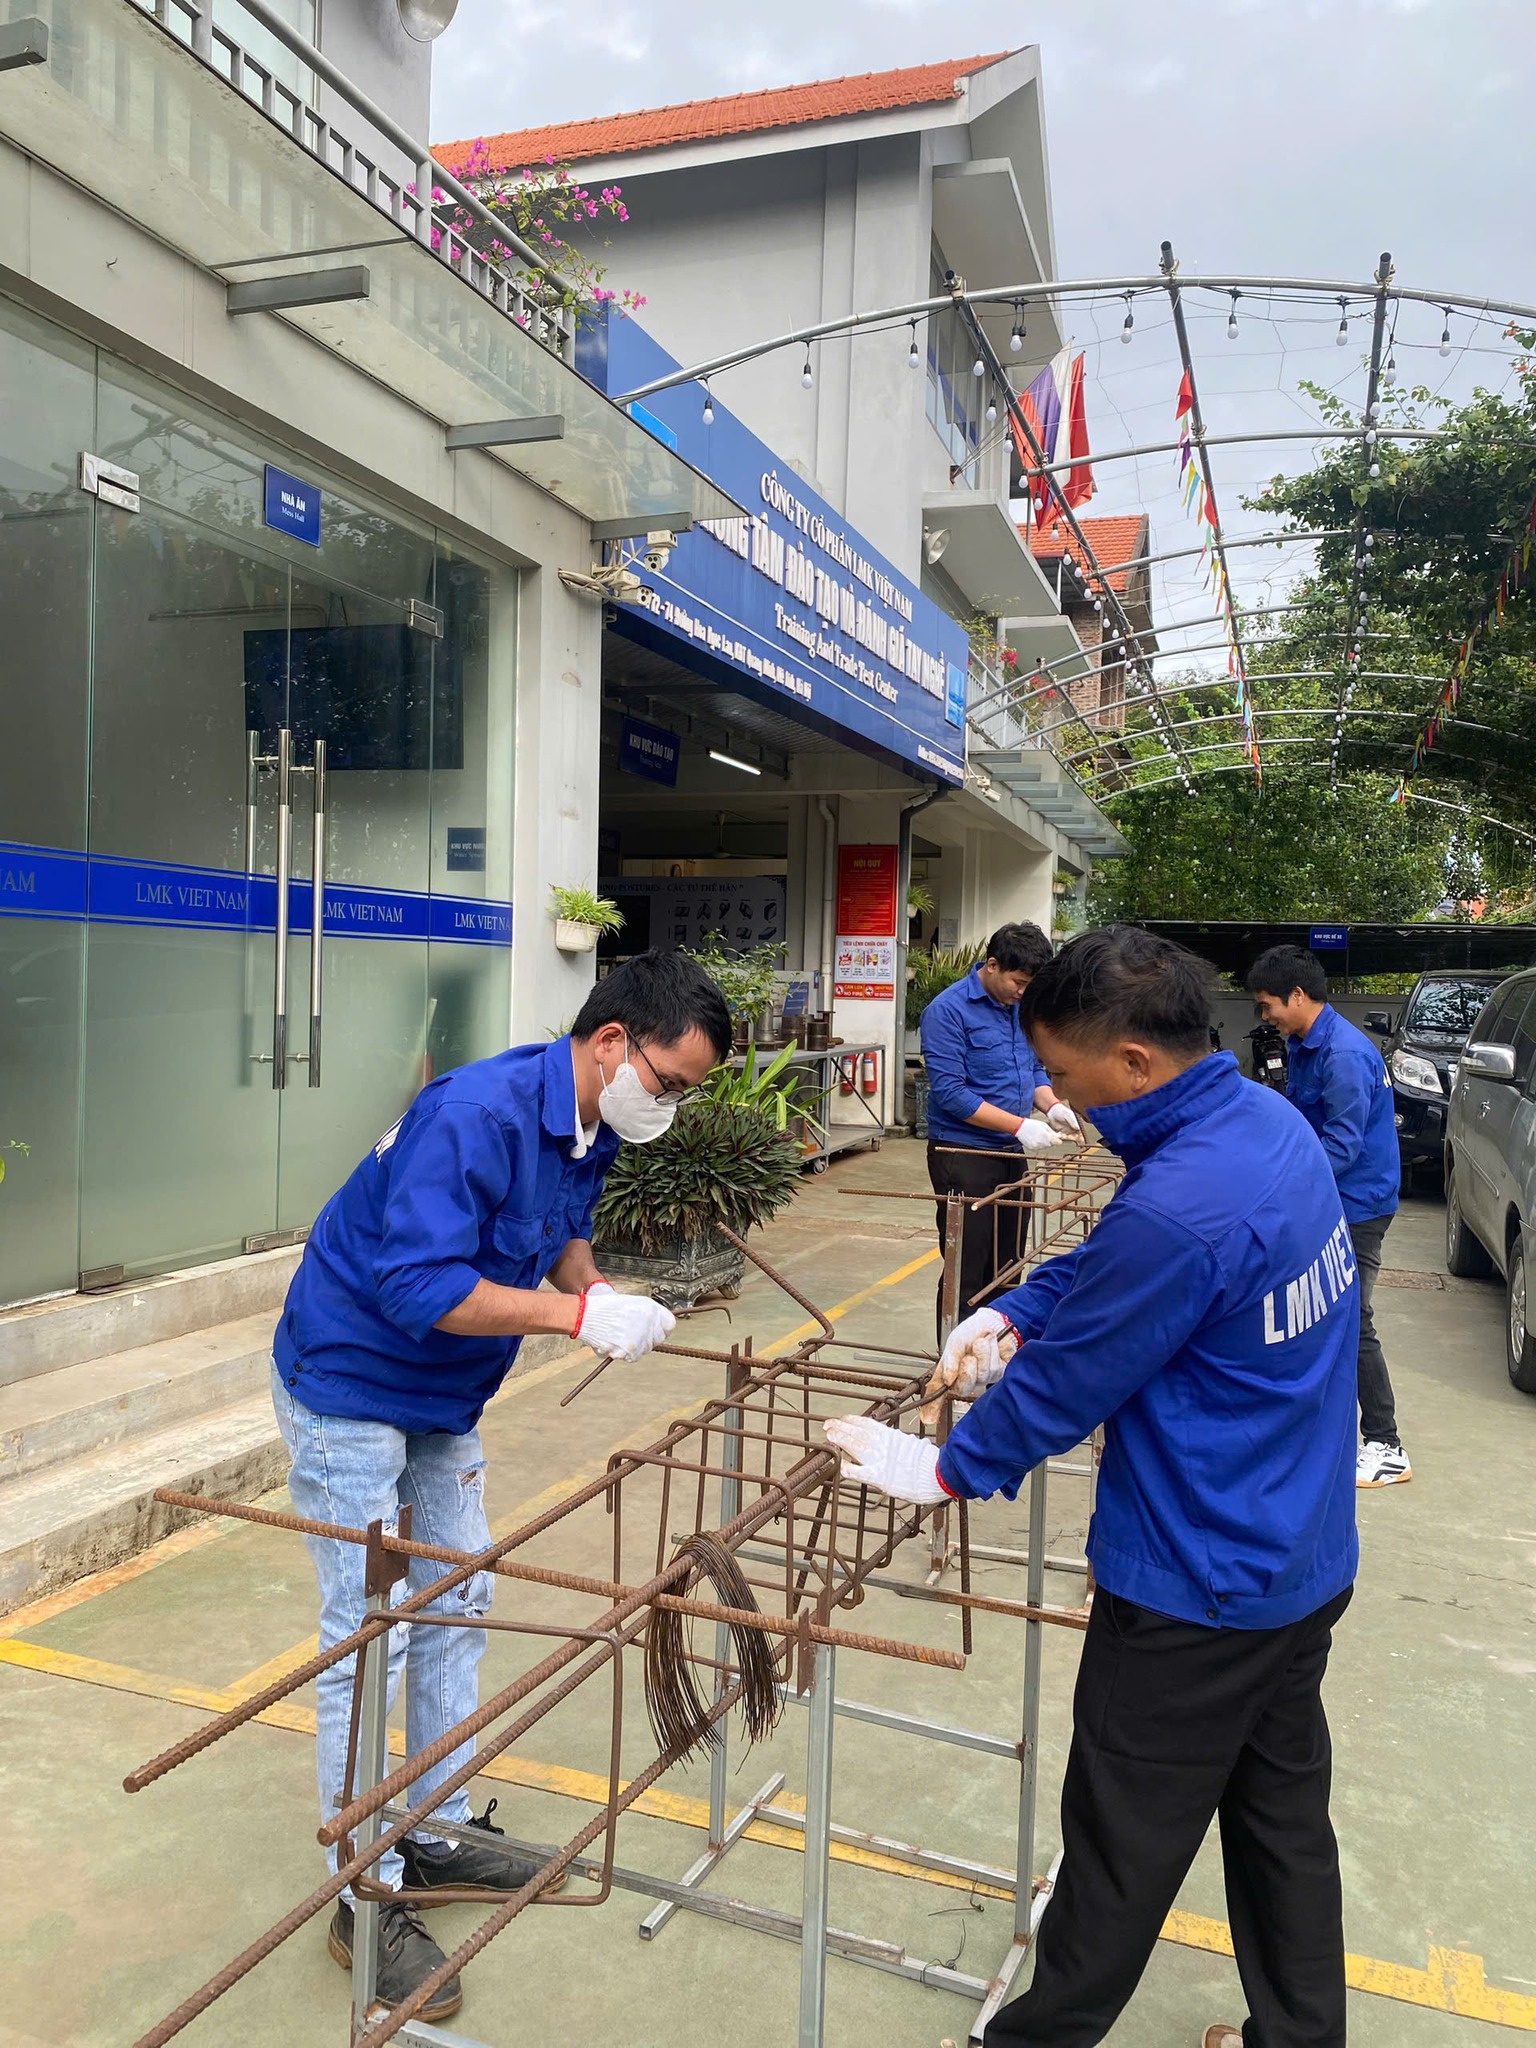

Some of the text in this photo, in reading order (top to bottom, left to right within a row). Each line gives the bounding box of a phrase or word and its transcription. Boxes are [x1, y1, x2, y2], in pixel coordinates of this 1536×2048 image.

[281, 491, 305, 512] NHÀ ĂN
[281, 506, 305, 523] Mess Hall
[761, 470, 795, 521] CÔNG
[795, 500, 810, 535] TY
[852, 552, 874, 590] LMK
[874, 570, 894, 609] VIỆT
[894, 592, 912, 623] NAM
[751, 512, 784, 585] TÂM
[785, 541, 815, 607] ĐÀO
[815, 567, 839, 630] TẠO
[775, 602, 898, 704] Training And Trade Test Center
[136, 882, 249, 911] LMK VIET NAM
[349, 903, 376, 921] VIET
[377, 907, 404, 923] NAM
[455, 912, 475, 928] LMK
[477, 914, 498, 930] VIET
[1263, 1215, 1356, 1344] LMK VIET
